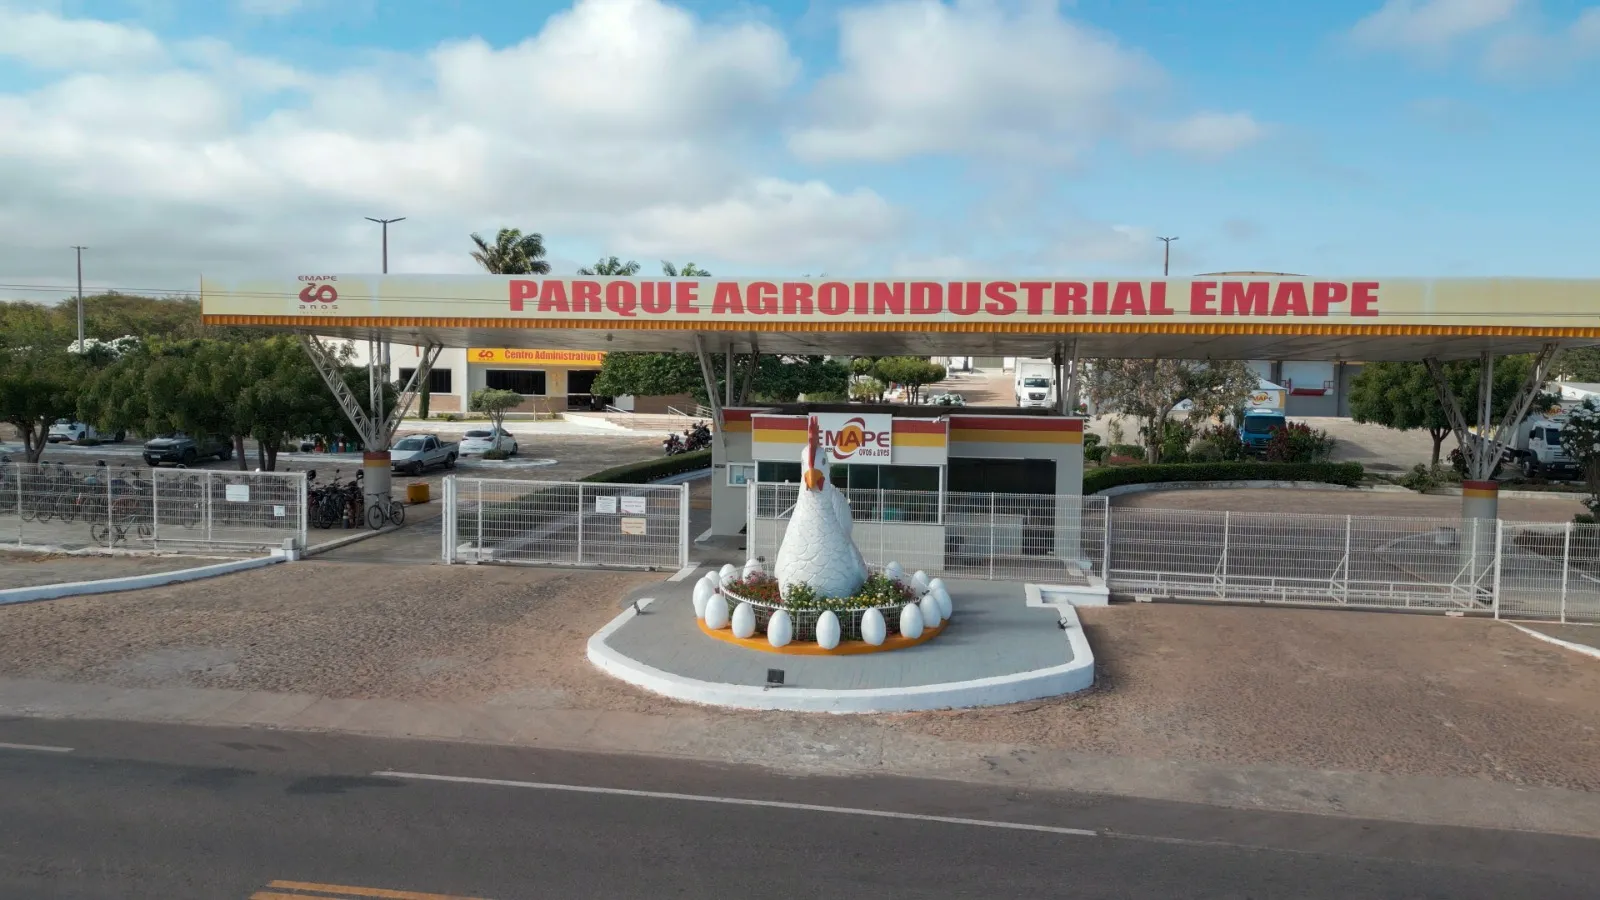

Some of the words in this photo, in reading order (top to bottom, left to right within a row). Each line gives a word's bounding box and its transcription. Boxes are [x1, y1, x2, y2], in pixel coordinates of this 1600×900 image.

[510, 280, 699, 317] PARQUE
[712, 282, 1172, 315] AGROINDUSTRIAL
[1190, 282, 1379, 316] EMAPE
[504, 350, 533, 359] Centro
[534, 351, 596, 361] Administrativo
